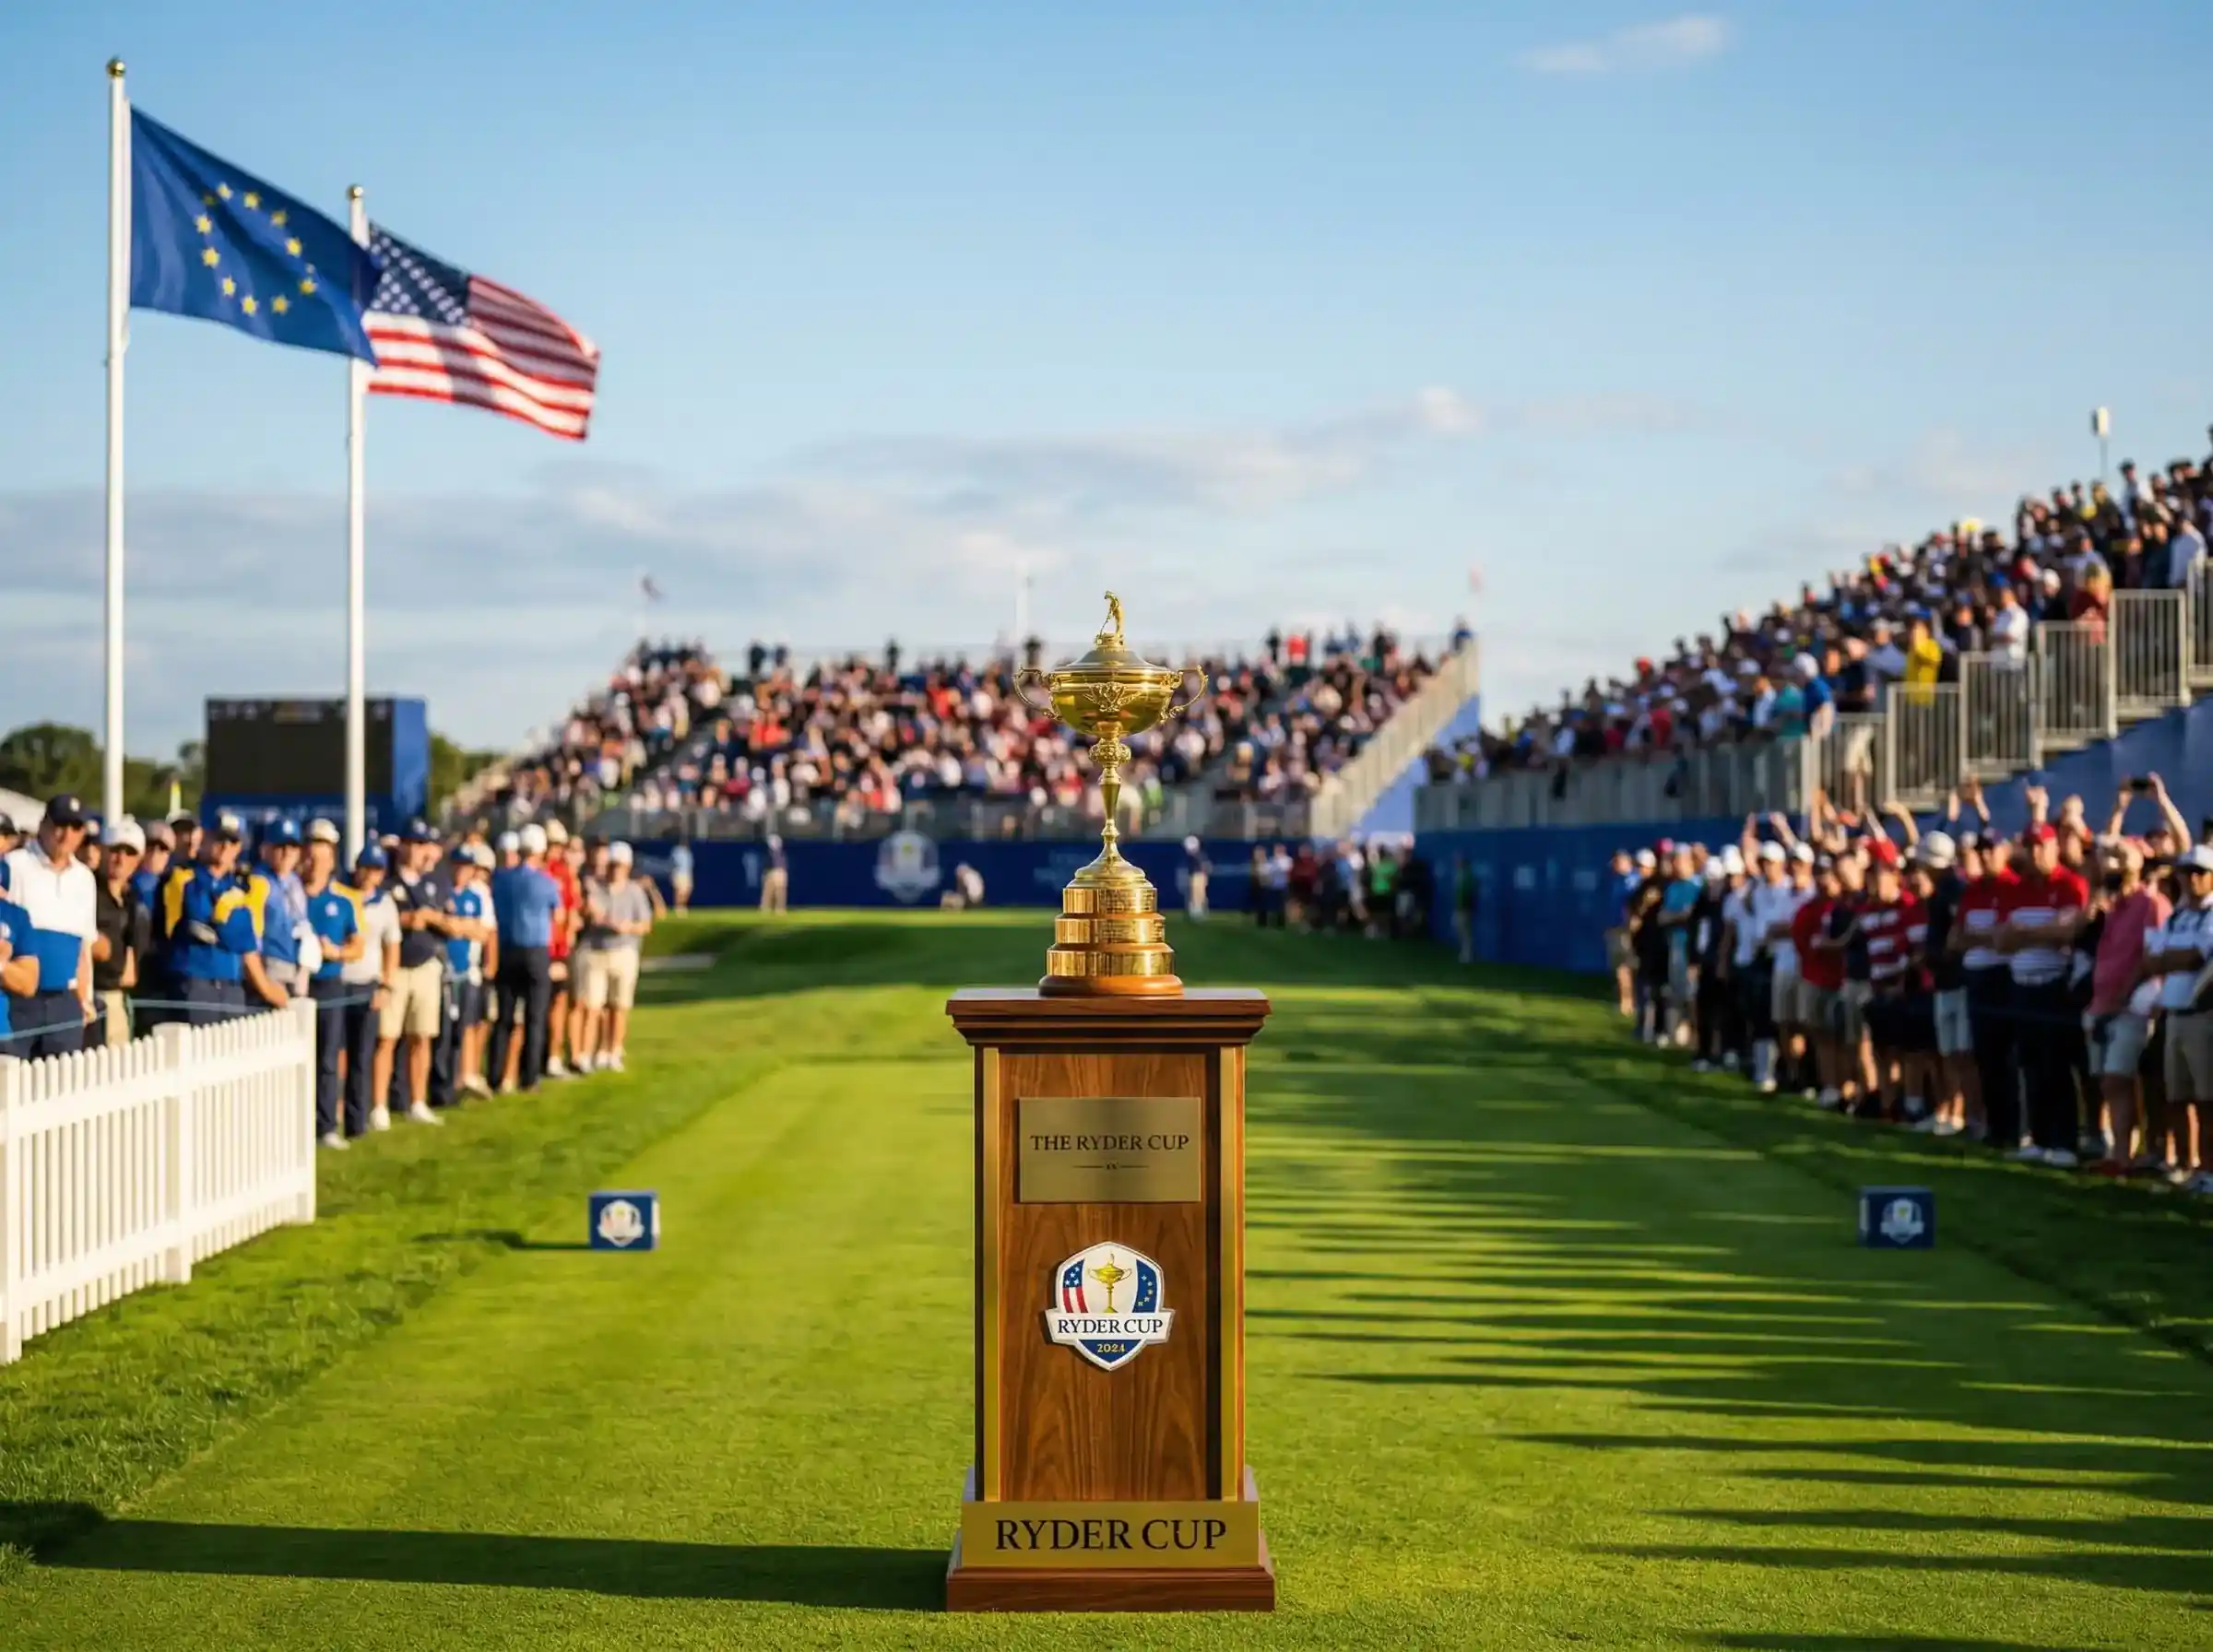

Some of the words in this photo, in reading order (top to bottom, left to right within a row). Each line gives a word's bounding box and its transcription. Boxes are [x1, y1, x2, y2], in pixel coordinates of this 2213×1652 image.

[1030, 1135, 1071, 1150] THE
[1076, 1135, 1143, 1150] RYDER
[1147, 1135, 1189, 1150] CUP
[1058, 1319, 1121, 1334] RYDER
[1124, 1319, 1163, 1334] CUP
[1096, 1343, 1125, 1353] 2024
[996, 1519, 1133, 1551] RYDER
[1142, 1519, 1226, 1551] CUP
